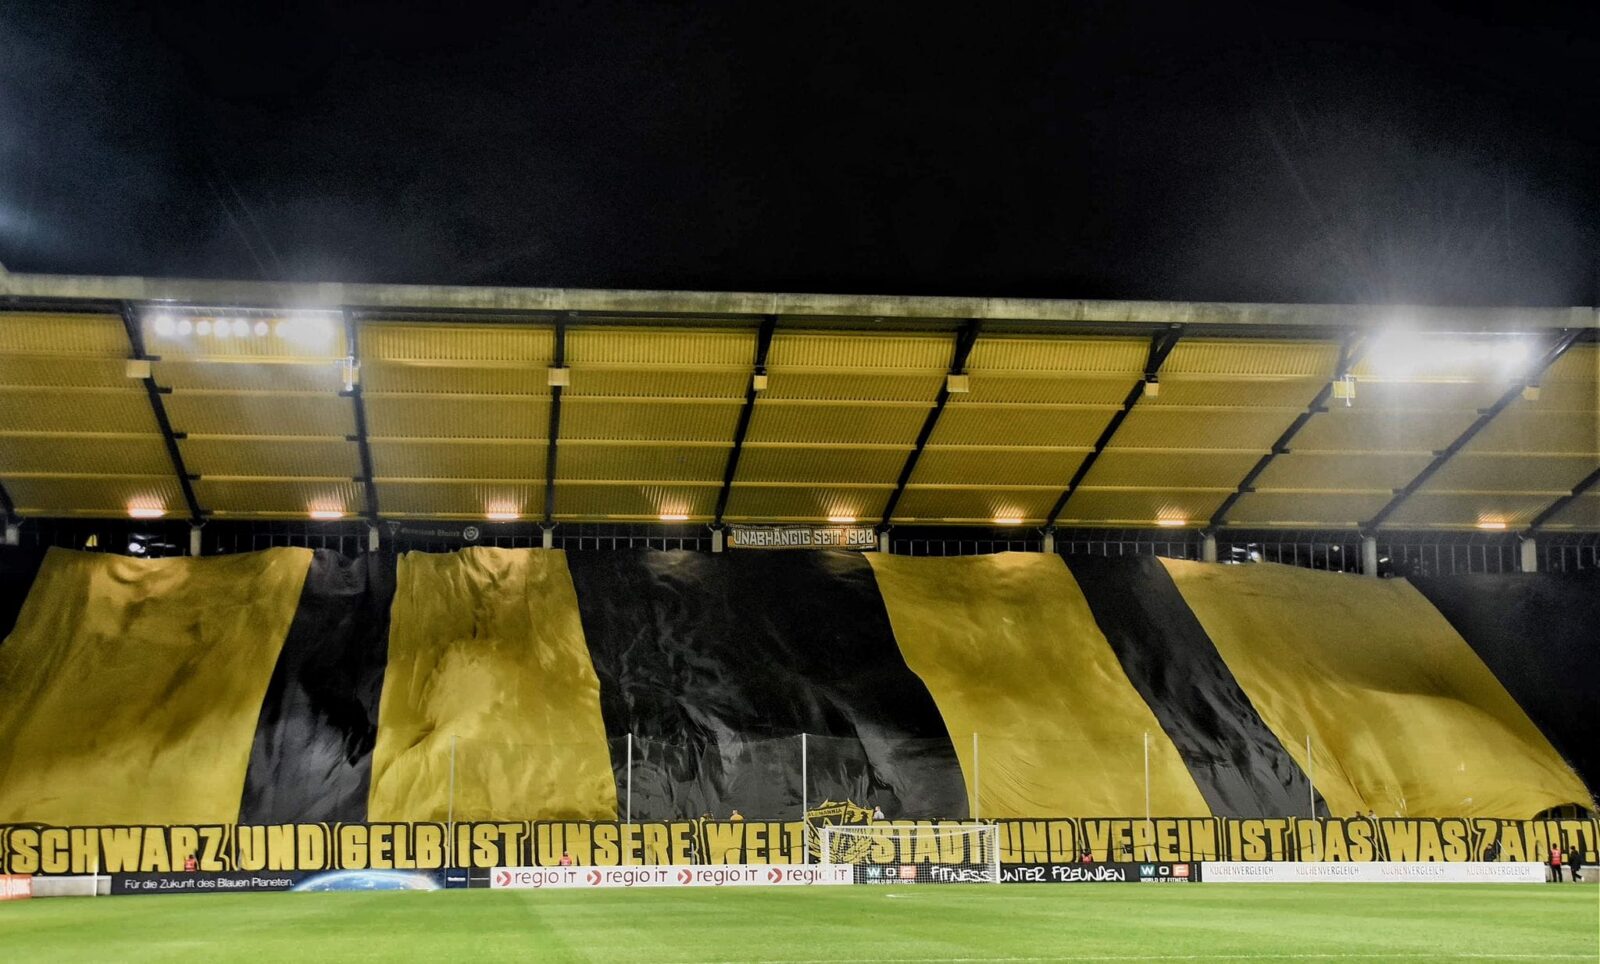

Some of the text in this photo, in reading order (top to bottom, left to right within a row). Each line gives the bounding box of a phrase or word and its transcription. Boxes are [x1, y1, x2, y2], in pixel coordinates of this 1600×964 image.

[733, 528, 874, 545] UNABHÄNGIG SEIT 1900
[807, 808, 843, 817] ALMANNIA
[11, 822, 805, 873] SCHWARZ UND GELB IST UNSERE WELT
[871, 820, 1597, 864] STADT UND VEREIN IST DAS WAS ZÄHLT!
[124, 877, 295, 889] Für die Zukunft des Blauen Planeten.
[514, 868, 559, 888] regio
[606, 867, 650, 886] regio
[696, 866, 740, 886] regio
[930, 866, 992, 882] FITNESS
[1052, 866, 1126, 882] FREUNDEN
